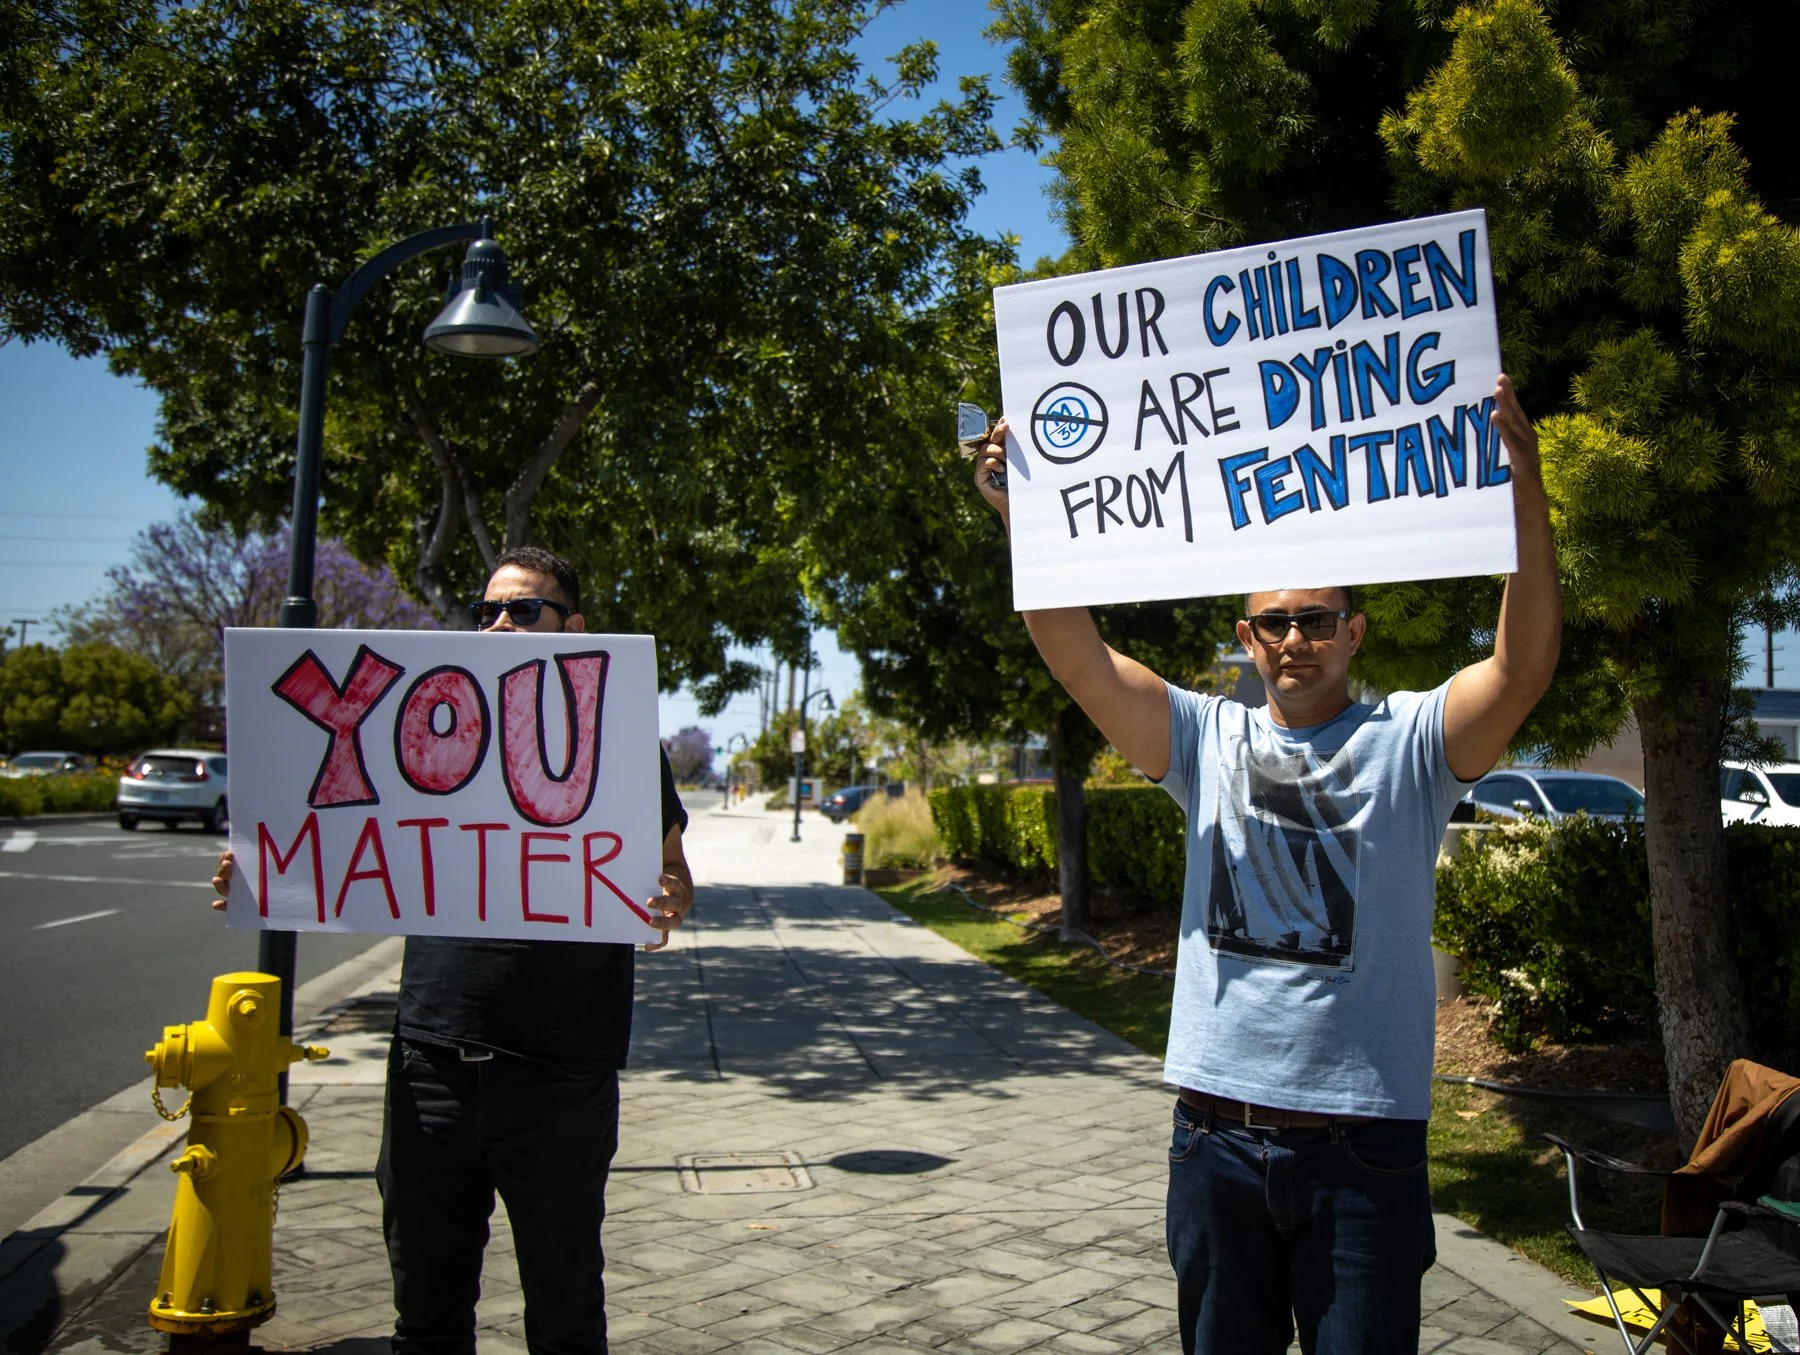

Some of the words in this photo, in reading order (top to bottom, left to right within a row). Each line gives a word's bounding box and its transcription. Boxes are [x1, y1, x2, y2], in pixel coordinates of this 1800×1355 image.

[1046, 286, 1169, 367] OUR
[1057, 418, 1081, 441] 30
[1134, 367, 1241, 451] ARE
[1060, 450, 1194, 543] FROM
[1217, 395, 1512, 532] FENTANYL
[271, 643, 611, 827] YOU
[257, 811, 652, 928] MATTER
